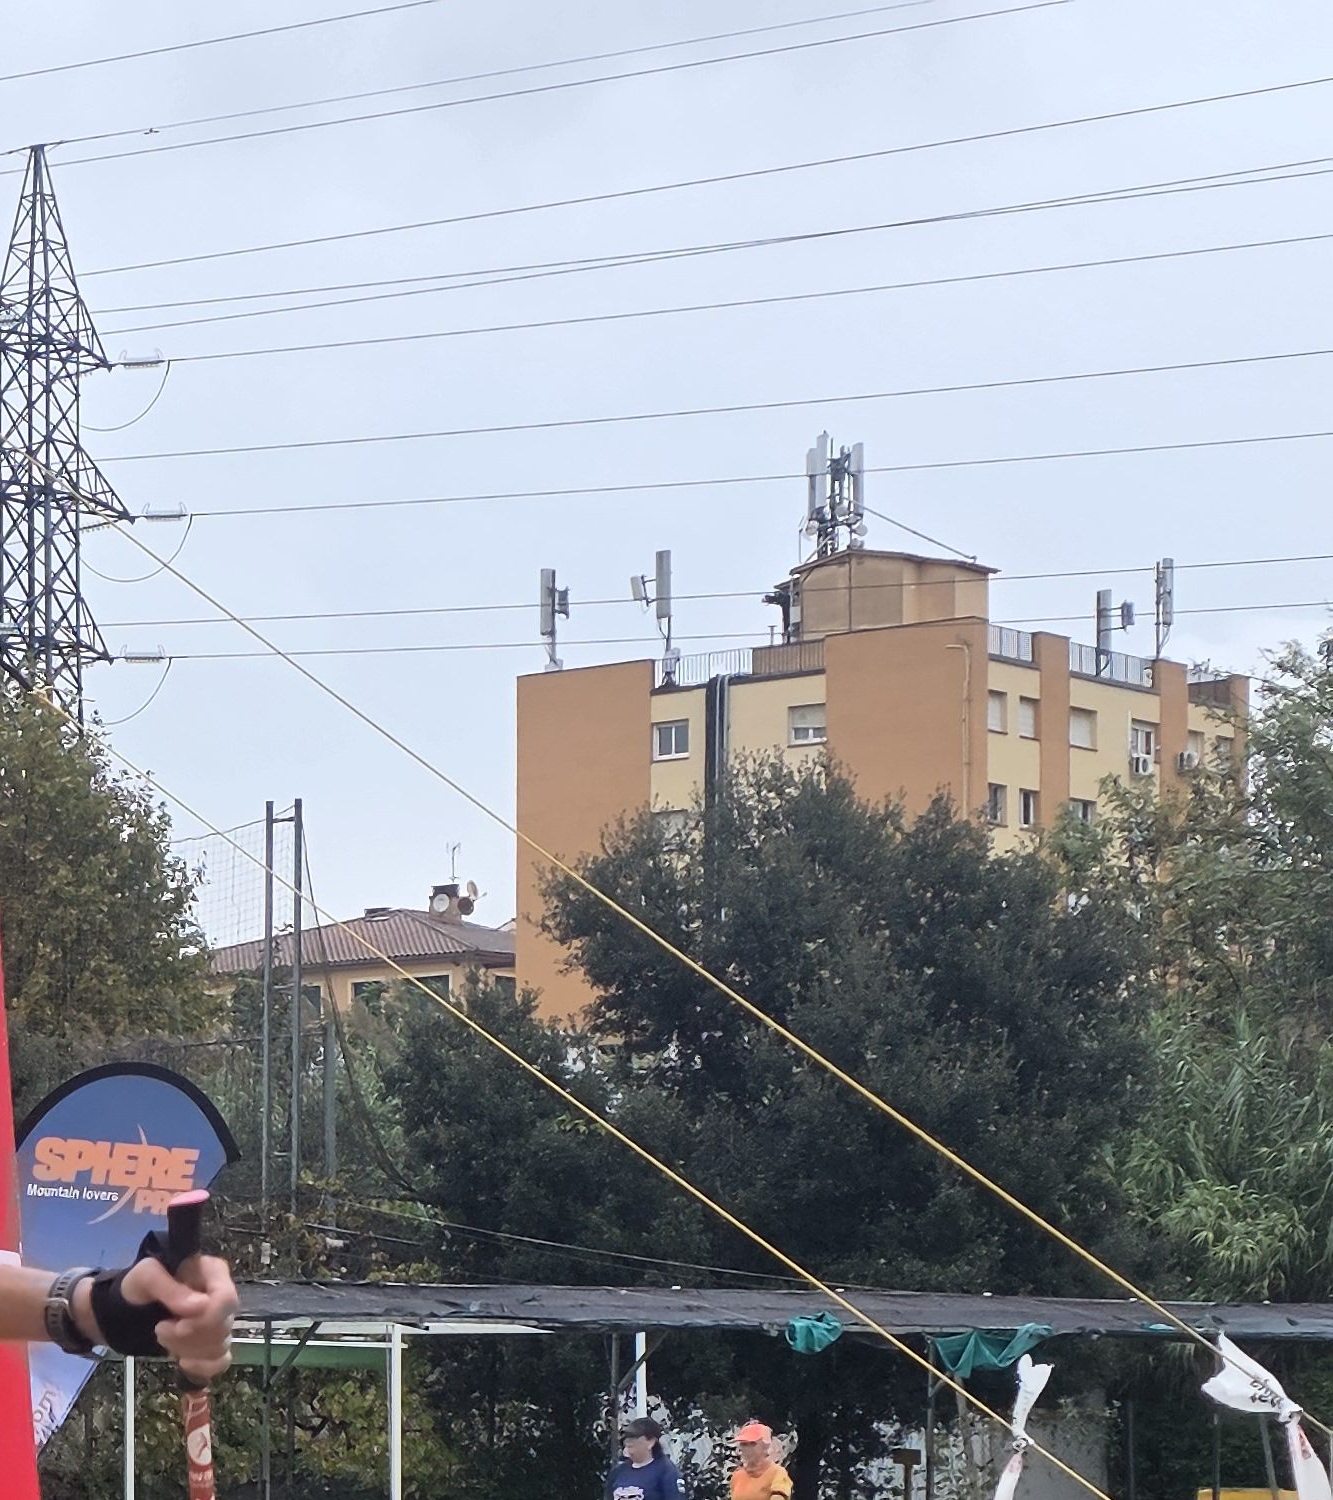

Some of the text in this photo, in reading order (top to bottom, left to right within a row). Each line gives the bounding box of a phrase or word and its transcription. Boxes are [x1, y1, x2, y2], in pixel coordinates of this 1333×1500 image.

[33, 1136, 201, 1191] SPHERE
[27, 1183, 120, 1202] Mountain lovers
